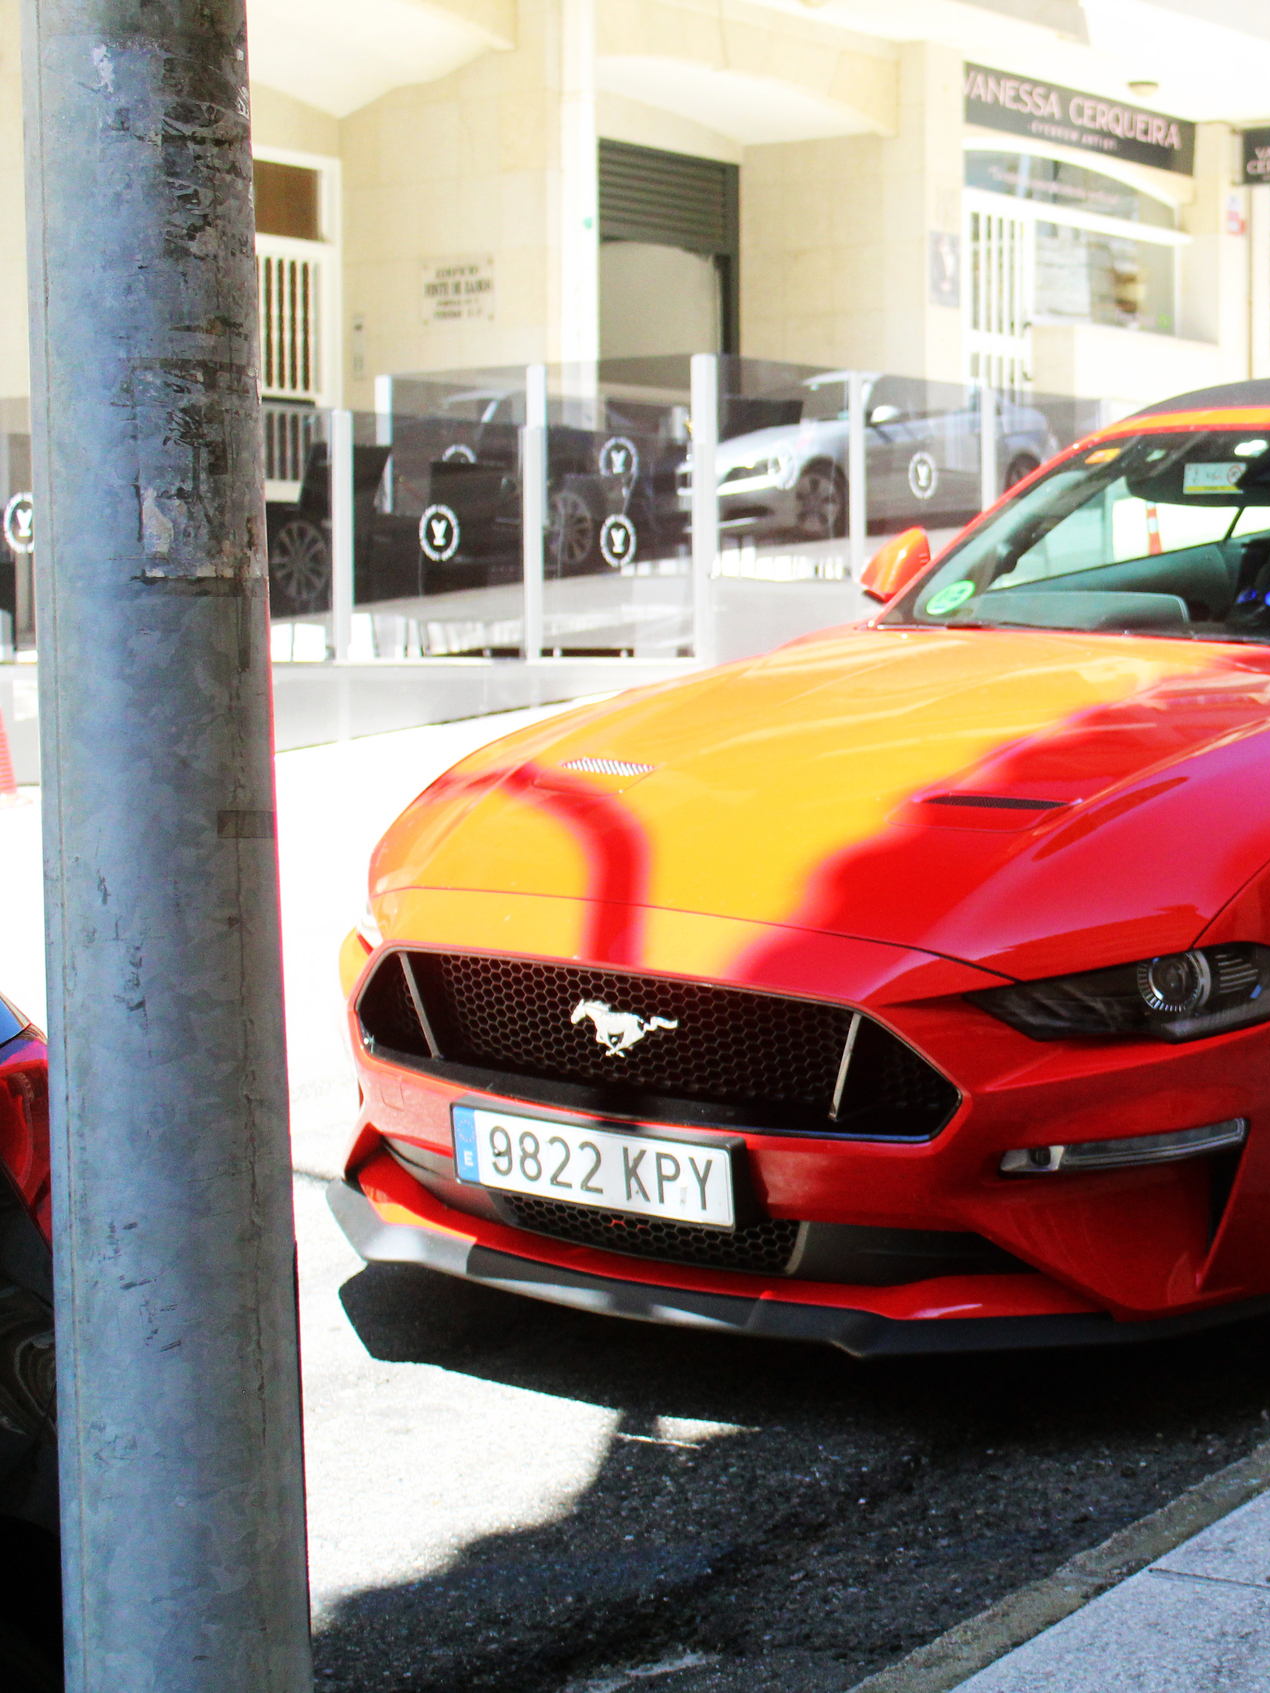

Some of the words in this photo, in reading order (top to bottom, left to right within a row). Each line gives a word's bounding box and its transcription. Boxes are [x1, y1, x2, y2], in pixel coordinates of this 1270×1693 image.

[963, 70, 1062, 119] VANESSA
[1069, 96, 1182, 150] CERQUEIRA
[463, 1151, 474, 1167] E
[488, 1125, 604, 1195] 9822
[622, 1146, 713, 1211] KPY
